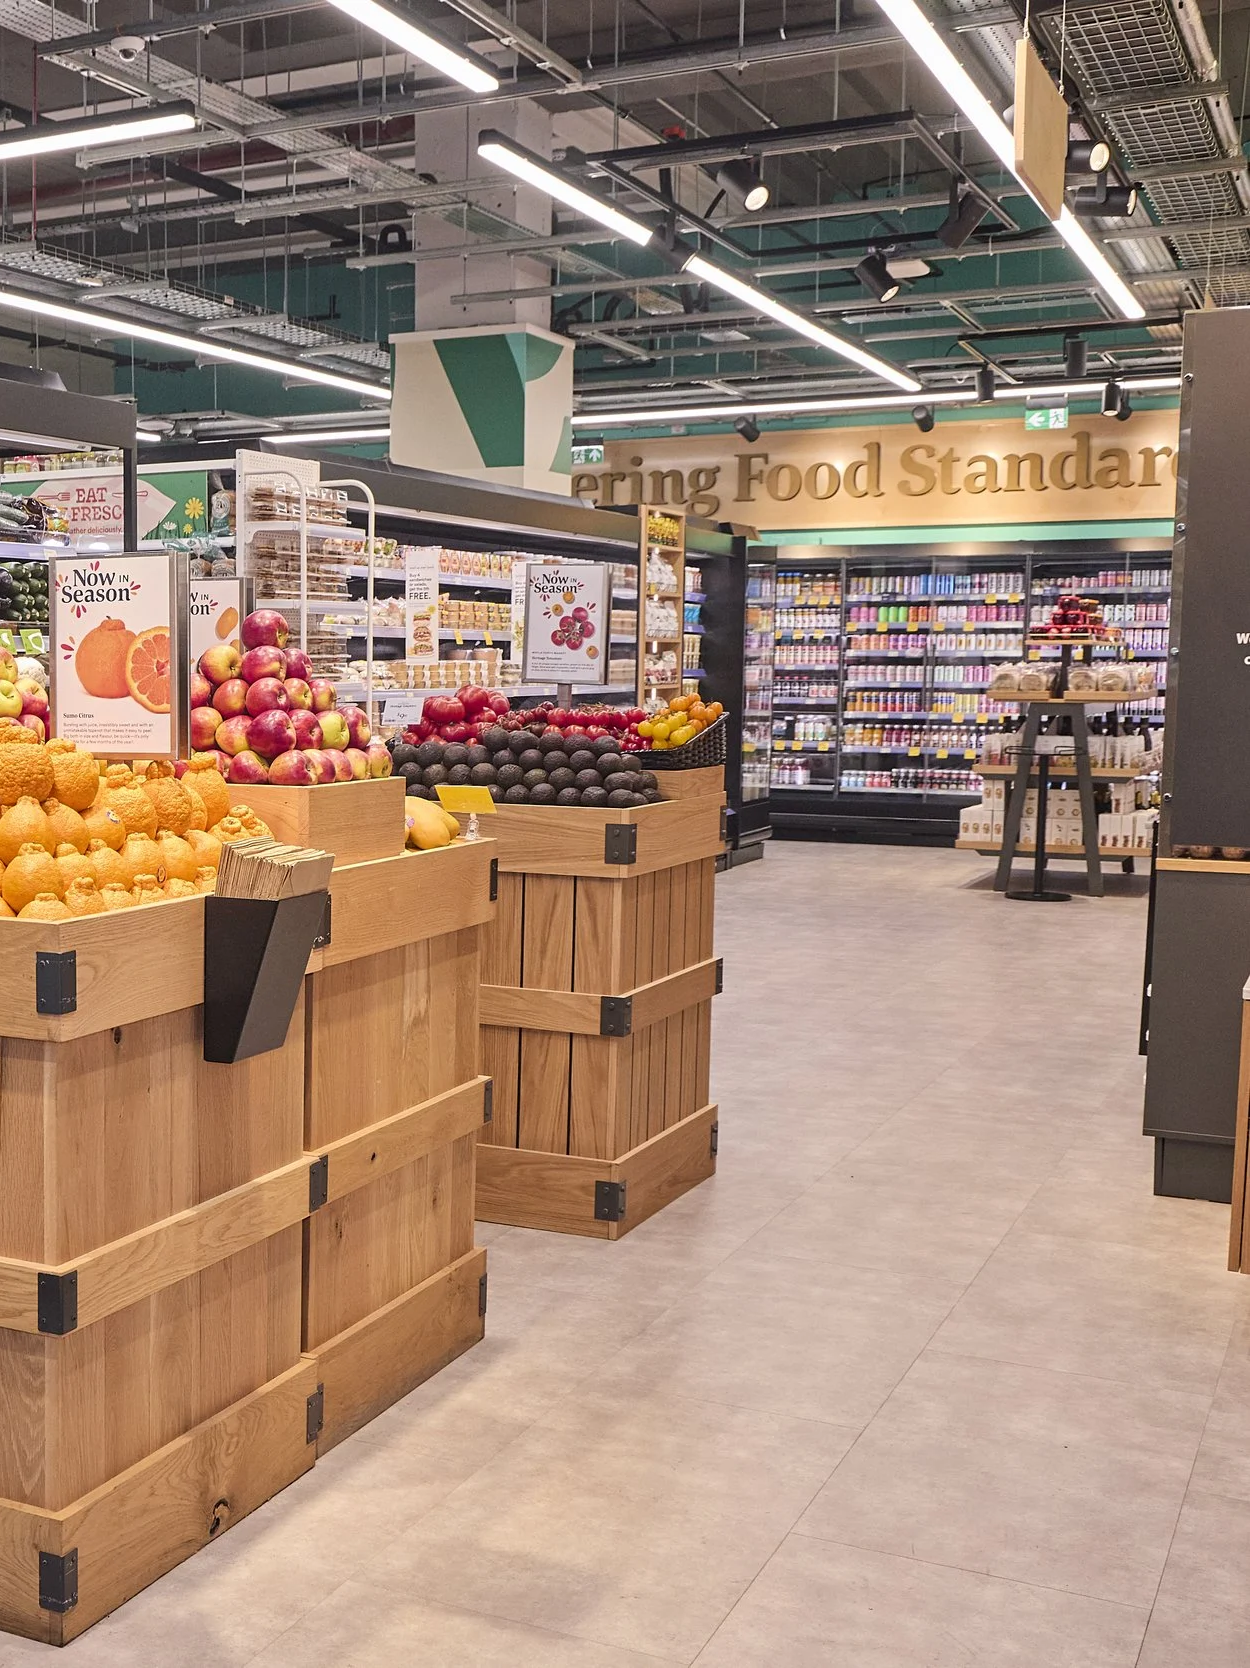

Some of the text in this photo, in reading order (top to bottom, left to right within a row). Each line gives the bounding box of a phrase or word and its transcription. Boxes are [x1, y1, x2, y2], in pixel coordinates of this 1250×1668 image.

[734, 441, 884, 502] Food
[897, 431, 1177, 497] Standar
[76, 487, 108, 503] EAT
[71, 505, 123, 522] FRESC
[69, 526, 124, 535] ather deliciously.
[73, 569, 129, 587] Now IN
[542, 573, 569, 585] Now
[61, 586, 131, 604] Season
[533, 583, 578, 594] Season
[201, 593, 209, 601] IN
[409, 592, 431, 600] FREE.
[1236, 632, 1250, 645] W
